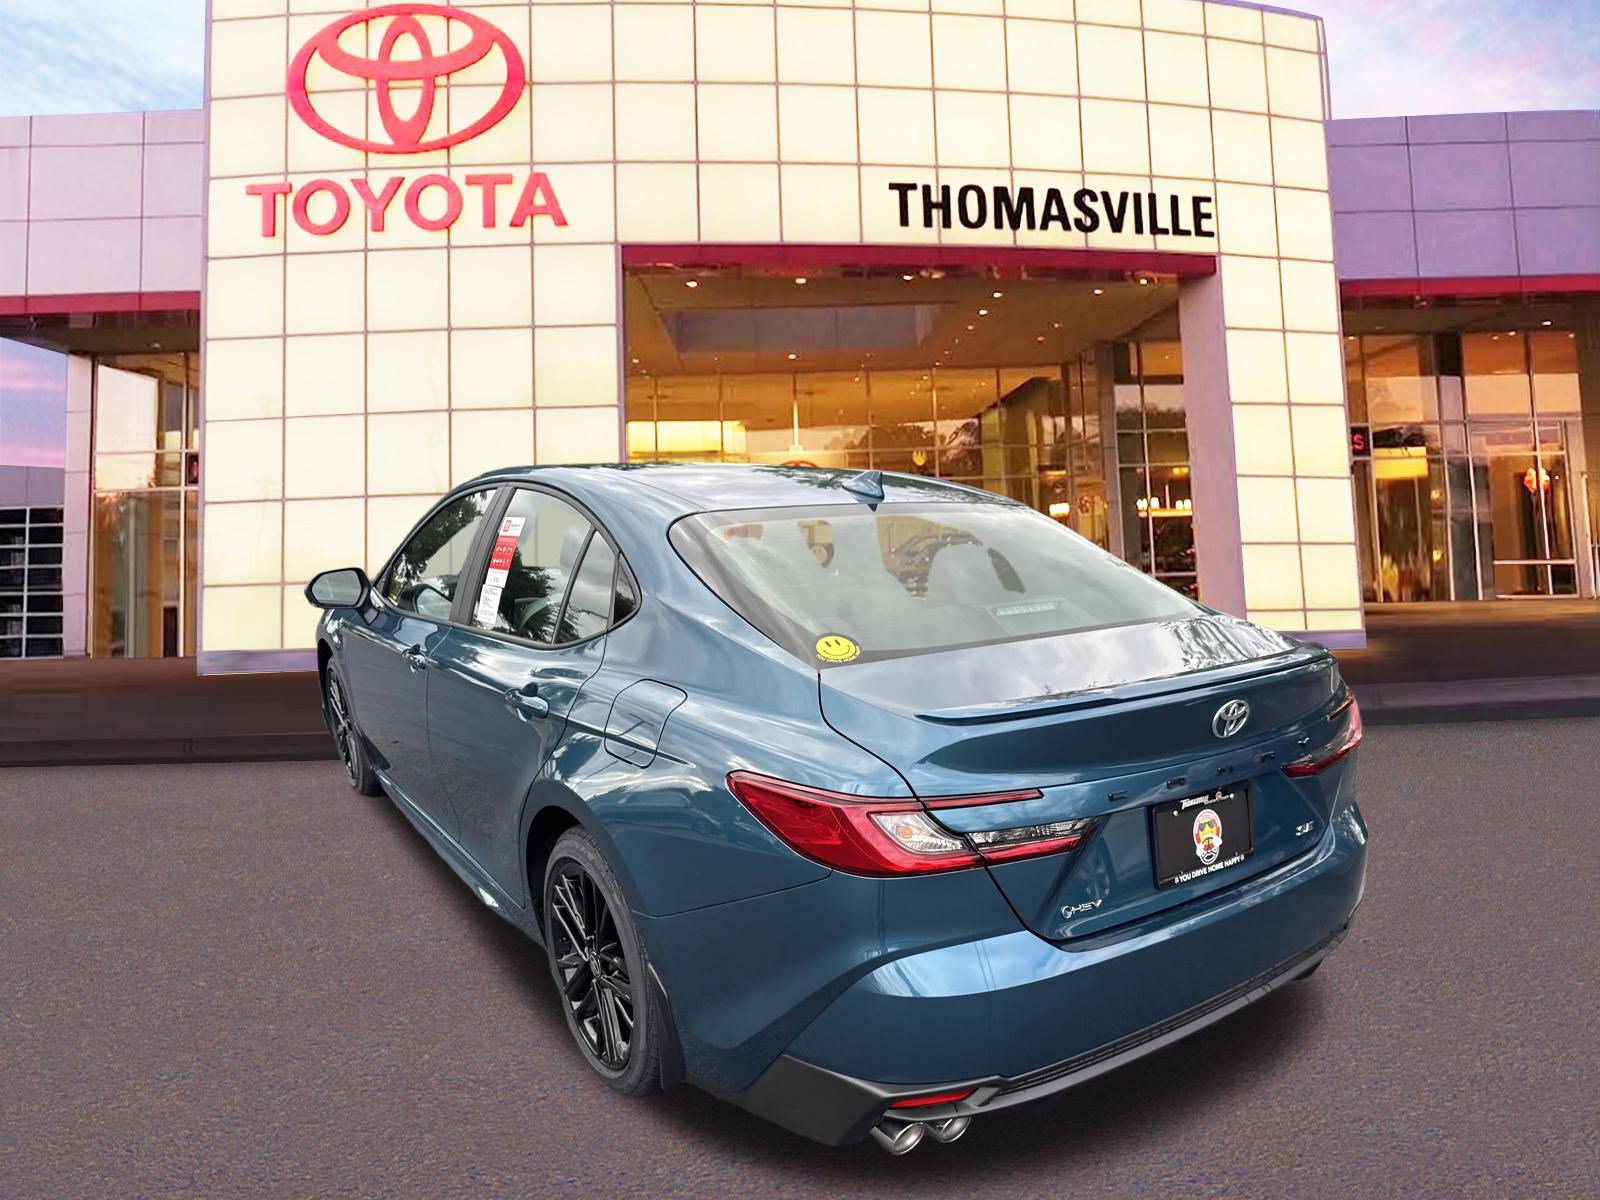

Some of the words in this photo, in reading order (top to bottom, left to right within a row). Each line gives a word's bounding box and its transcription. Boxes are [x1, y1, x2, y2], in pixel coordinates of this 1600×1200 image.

[246, 172, 568, 237] TOYOTA
[888, 182, 1215, 238] THOMASVILLE
[1179, 872, 1191, 882] YOU
[1191, 867, 1207, 879] DRIVE
[1207, 861, 1224, 873] HOME
[1224, 855, 1241, 867] HAPPY
